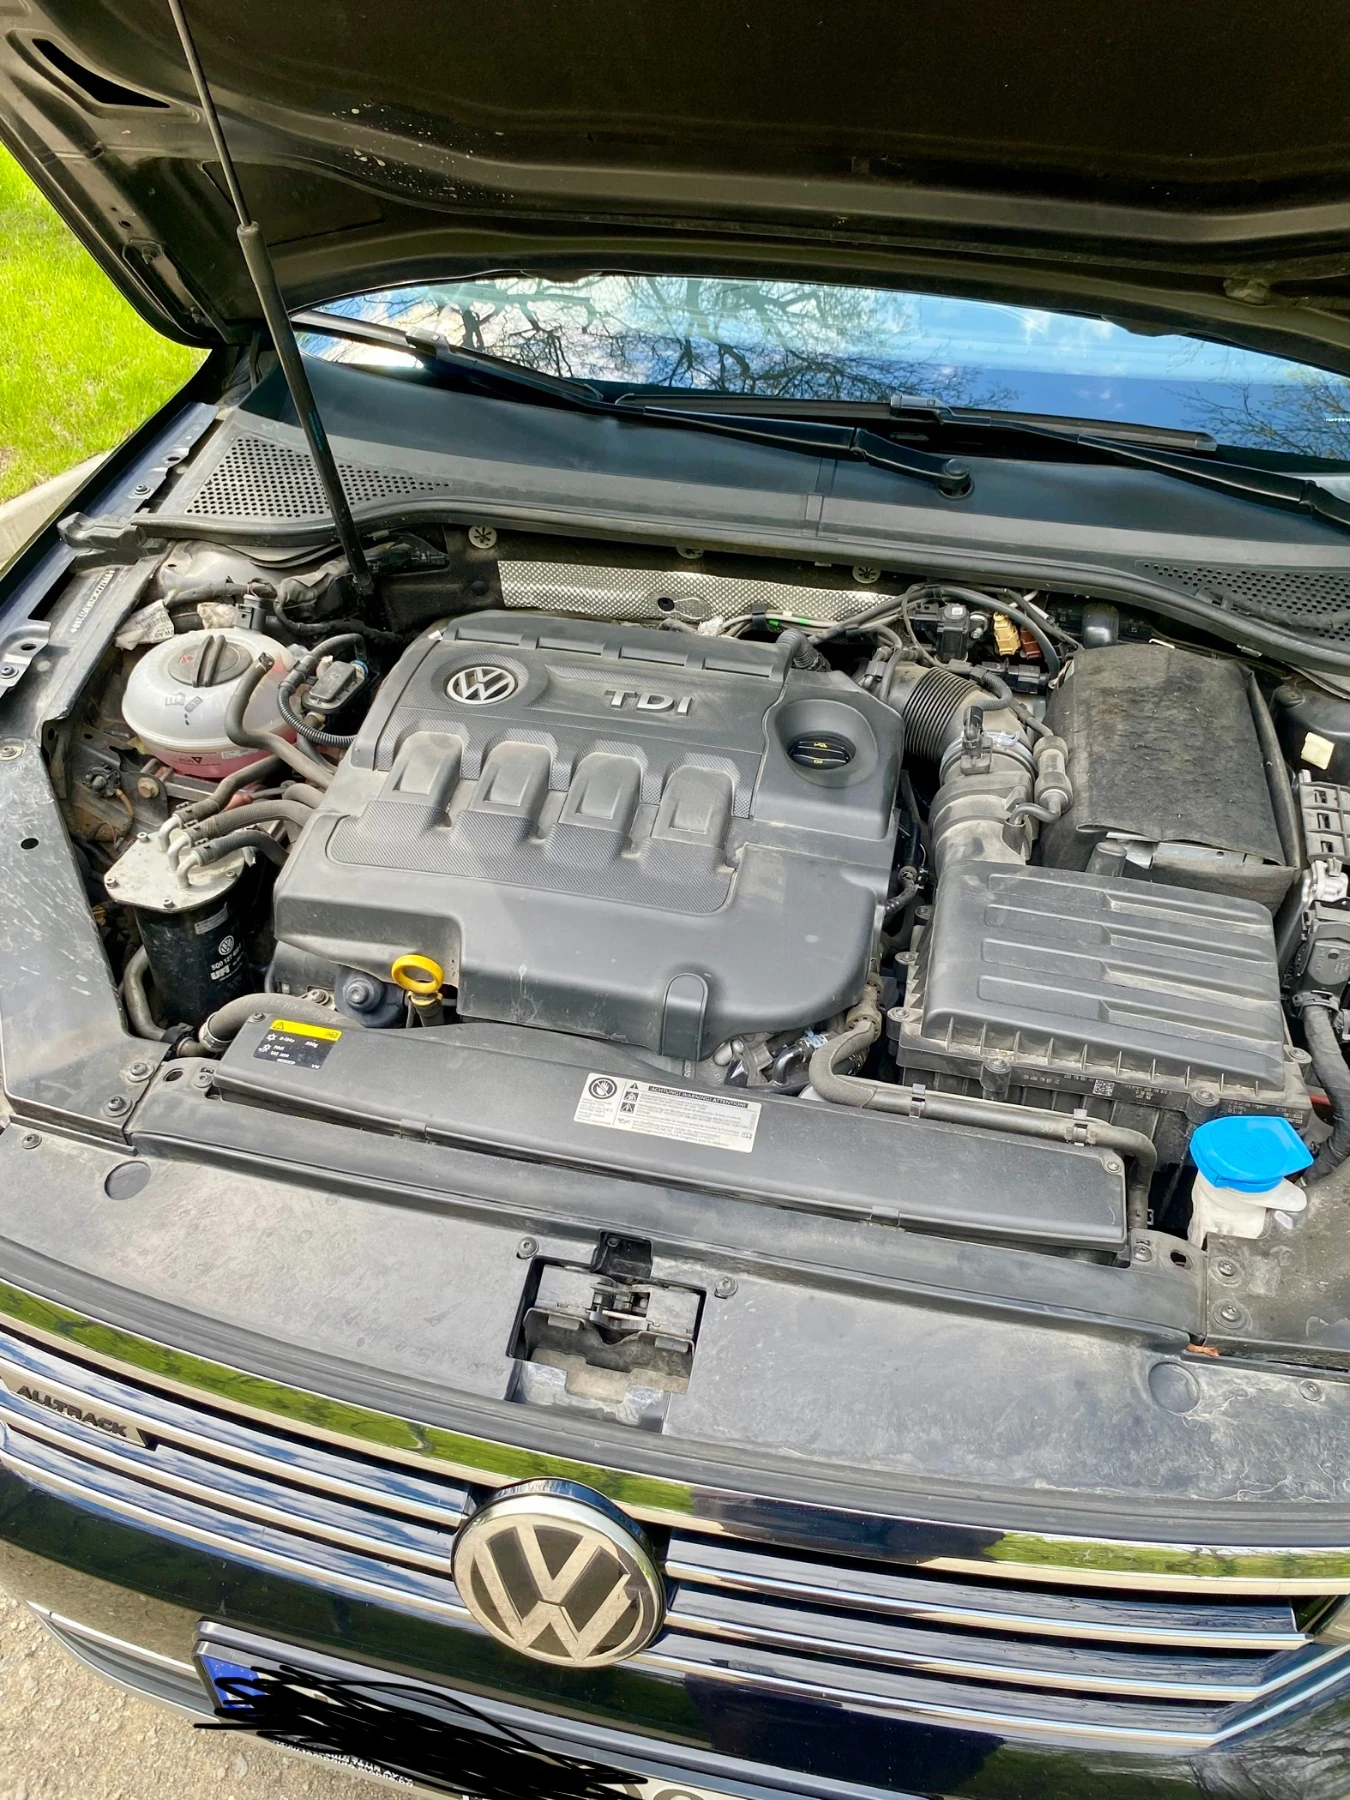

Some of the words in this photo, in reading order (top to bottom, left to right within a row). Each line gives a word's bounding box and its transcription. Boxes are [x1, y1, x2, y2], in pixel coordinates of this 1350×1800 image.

[447, 666, 516, 705] VW
[605, 690, 693, 716] TDI
[651, 1087, 681, 1097] ACHTUNG!
[682, 1092, 711, 1102] WARNING!
[713, 1098, 747, 1108] ATTENTION!
[16, 1385, 128, 1438] ALLTRACK
[453, 1497, 660, 1667] VW
